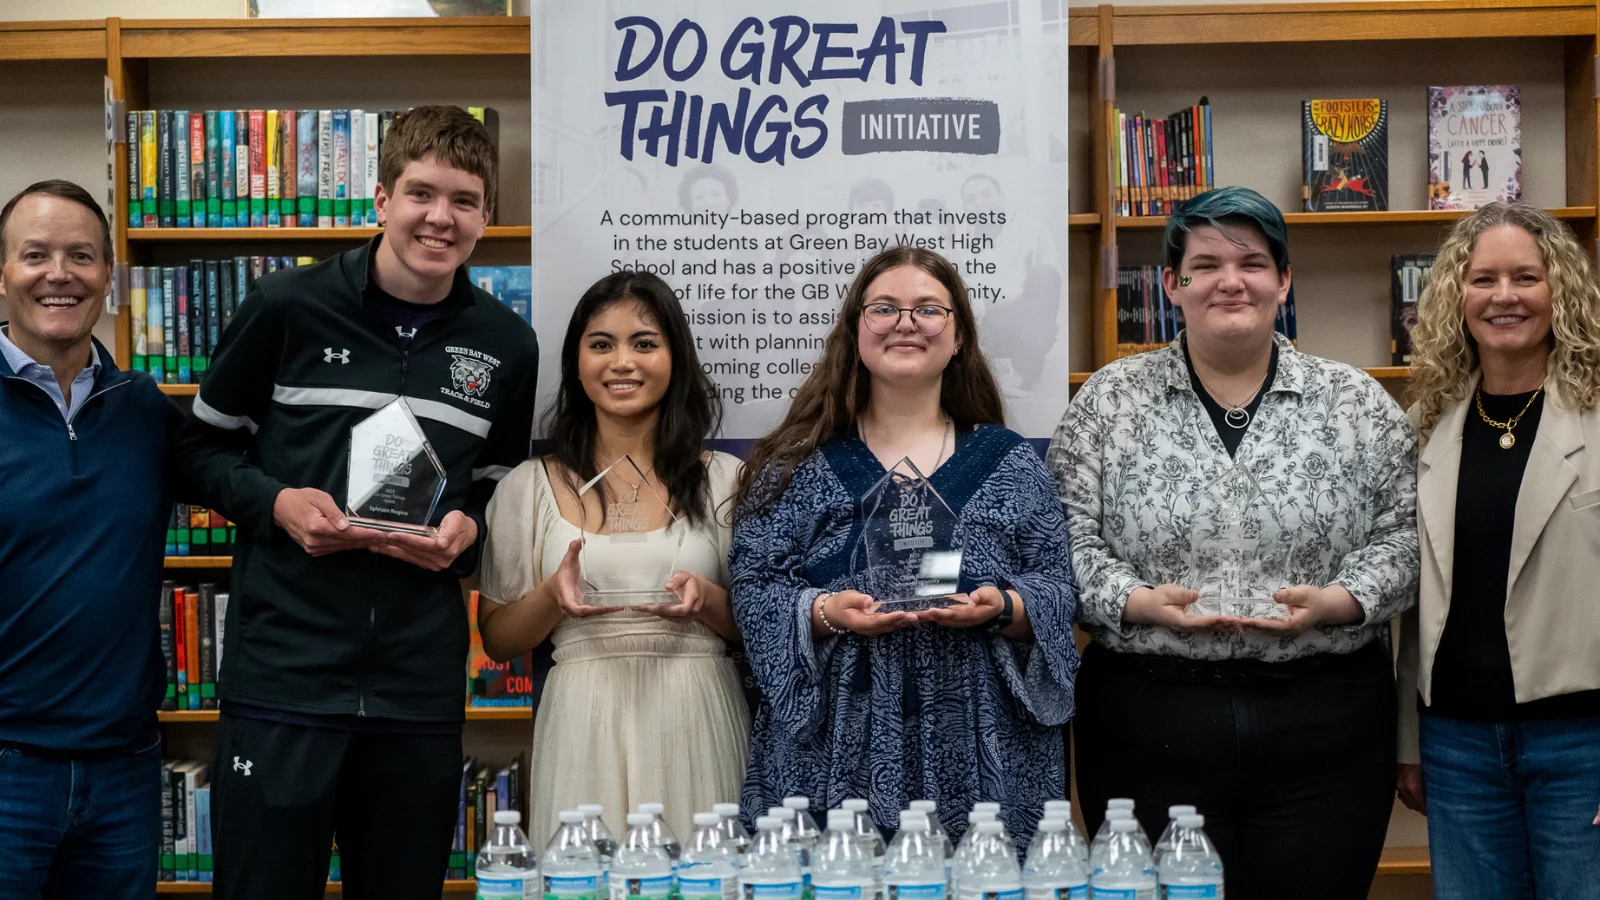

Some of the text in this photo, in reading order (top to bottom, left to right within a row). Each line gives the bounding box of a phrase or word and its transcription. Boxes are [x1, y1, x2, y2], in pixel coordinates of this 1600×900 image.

[614, 15, 947, 87] DO GREAT
[1321, 100, 1375, 113] FOOTSTEPS
[1450, 102, 1455, 112] A
[604, 87, 981, 167] THINGS INITIATIVE
[1316, 113, 1376, 141] CRAZY HORSE
[1447, 113, 1508, 136] CANCER
[321, 121, 331, 157] BREAKUP
[301, 143, 313, 178] ROOK
[321, 161, 331, 187] FROM
[600, 208, 1007, 230] A community-based program that invests
[613, 233, 993, 254] in the students at Green Bay West High
[610, 259, 675, 276] School
[681, 259, 717, 275] and
[723, 259, 756, 275] has
[762, 262, 773, 275] a
[779, 258, 855, 279] positive
[965, 258, 996, 275] the
[673, 283, 692, 300] of
[697, 283, 726, 300] life
[731, 283, 758, 300] for
[760, 283, 795, 300] the
[802, 283, 829, 300] GB
[752, 308, 767, 325] is
[774, 310, 793, 325] to
[709, 333, 749, 350] with
[755, 333, 825, 354] plannin
[445, 346, 501, 367] GREEN BAY WEST
[701, 358, 760, 379] oming
[440, 387, 464, 400] TRACK
[470, 397, 490, 408] FIELD
[705, 383, 745, 404] ding
[751, 383, 783, 399] the
[385, 433, 403, 447] DO
[373, 444, 415, 462] GREAT
[372, 457, 413, 476] THINGS
[369, 505, 390, 513] Ephraim
[607, 502, 646, 517] GREAT
[900, 494, 919, 507] DO
[607, 515, 649, 531] THINGS
[889, 506, 932, 523] GREAT
[889, 520, 934, 538] THINGS
